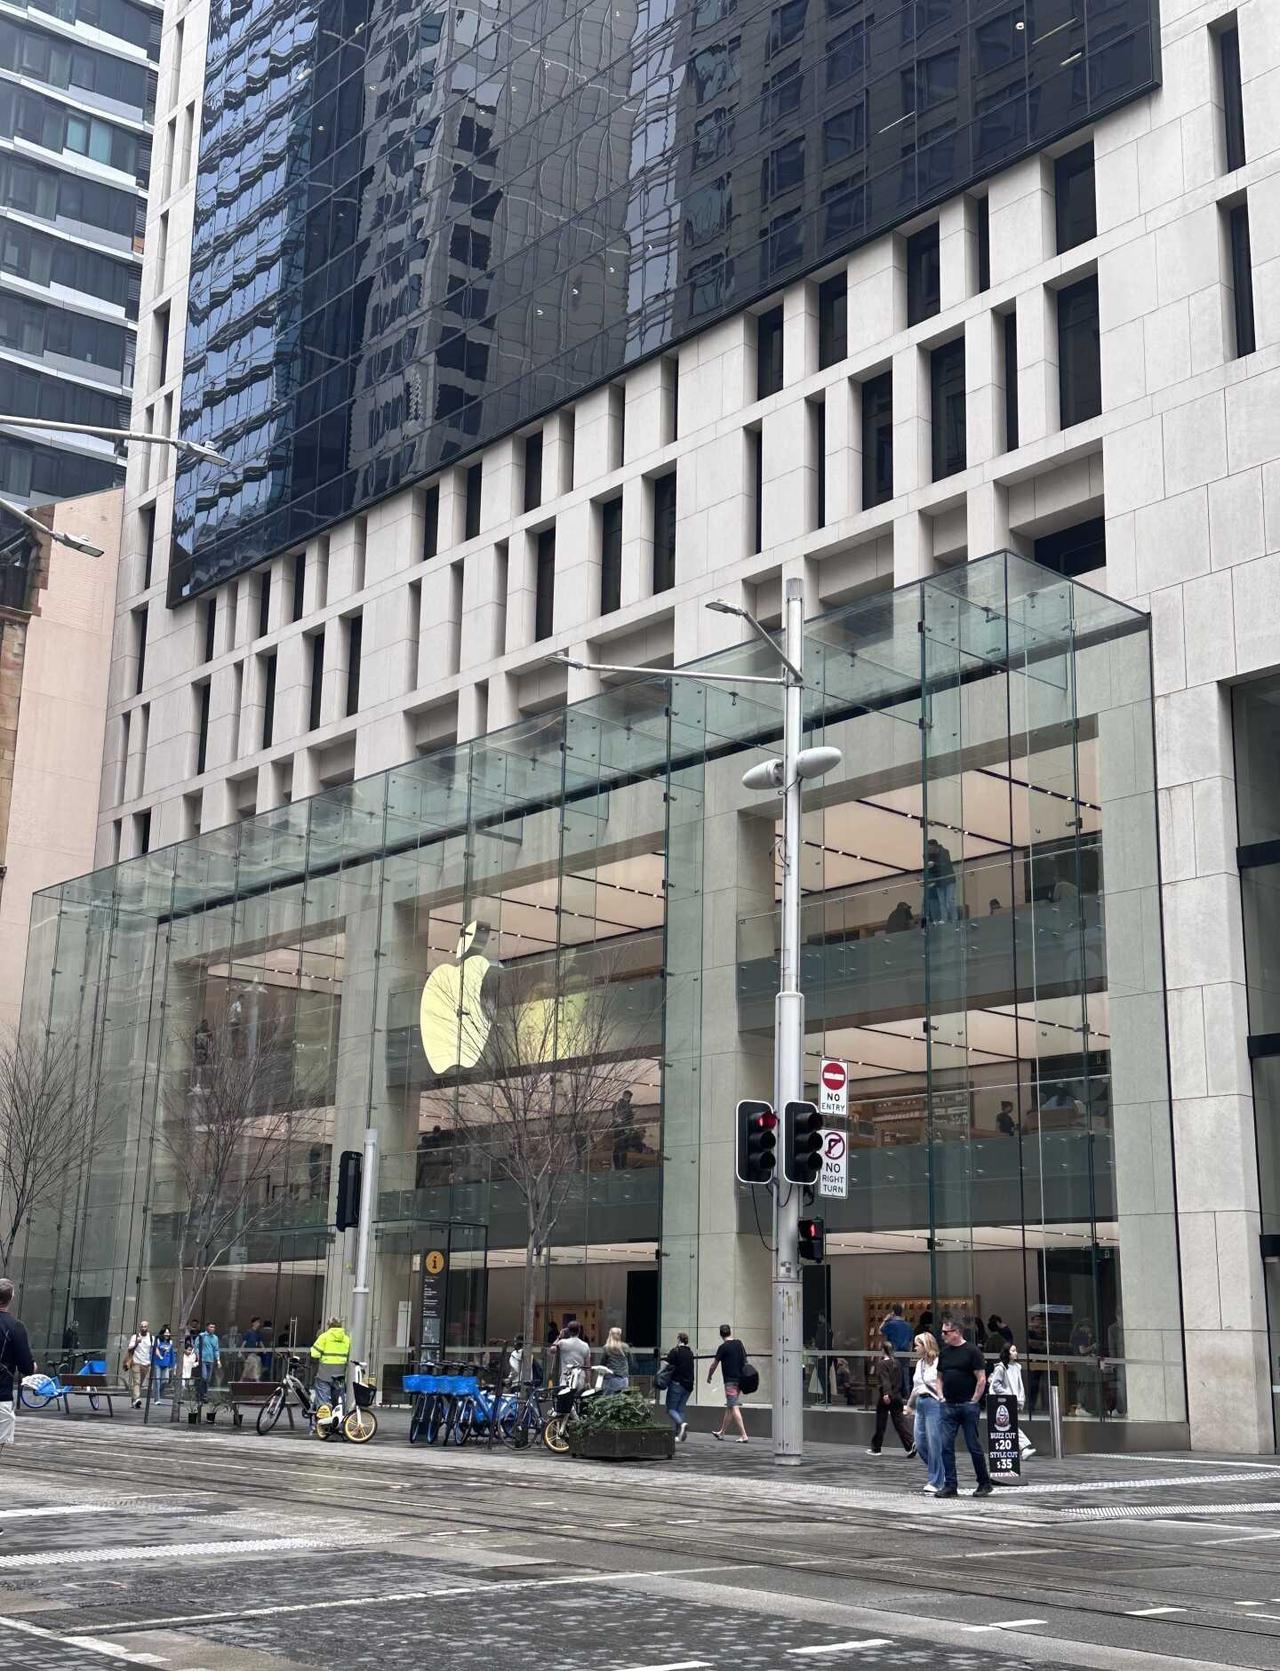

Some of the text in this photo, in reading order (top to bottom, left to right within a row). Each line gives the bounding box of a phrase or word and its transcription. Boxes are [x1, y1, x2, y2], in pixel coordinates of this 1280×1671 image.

[826, 1092, 840, 1102] NO
[822, 1102, 845, 1111] ENTRY
[825, 1162, 841, 1173] NO
[822, 1175, 844, 1184] RIGHT
[823, 1184, 844, 1194] TURN
[996, 1440, 1012, 1450] $20
[996, 1459, 1012, 1469] $35
